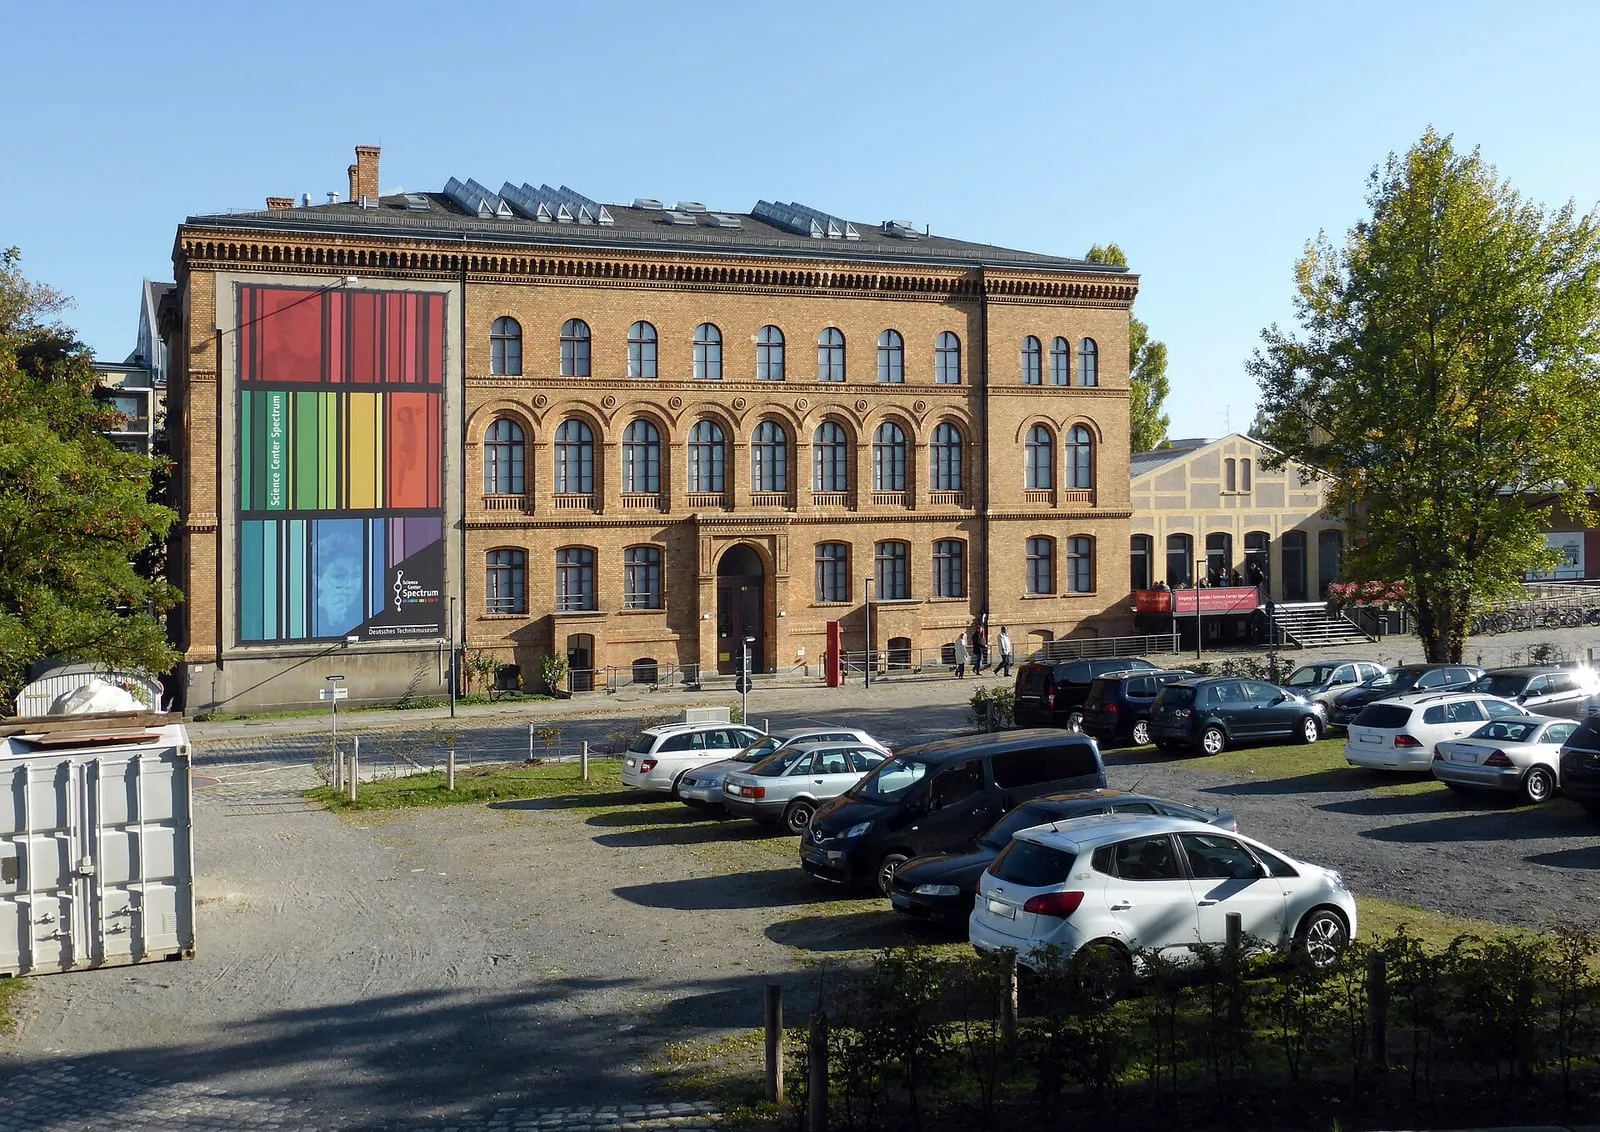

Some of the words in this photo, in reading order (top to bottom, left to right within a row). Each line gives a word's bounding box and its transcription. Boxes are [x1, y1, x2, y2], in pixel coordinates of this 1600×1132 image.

[271, 395, 282, 438] Spectrum
[271, 441, 280, 470] Center
[271, 473, 280, 506] Science
[402, 589, 439, 598] Spectrum
